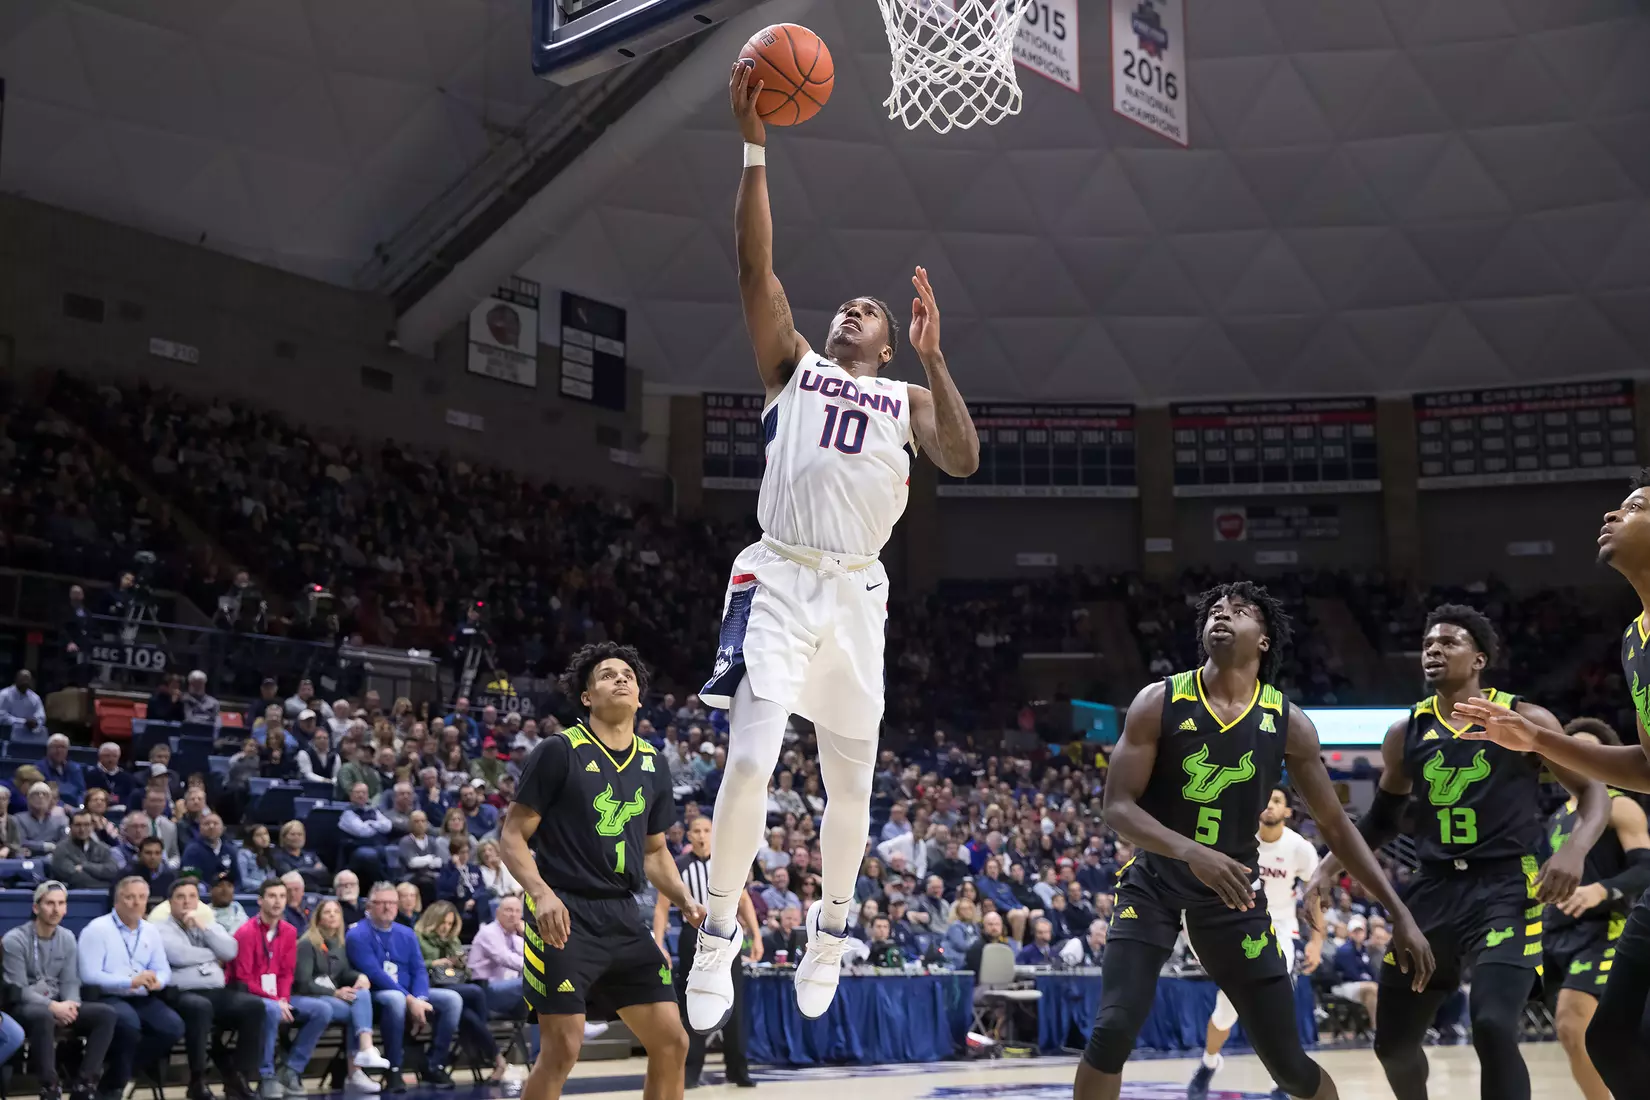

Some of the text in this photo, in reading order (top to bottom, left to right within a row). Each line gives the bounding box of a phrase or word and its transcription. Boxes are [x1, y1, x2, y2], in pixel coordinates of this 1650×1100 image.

[1013, 44, 1071, 82] HAMPIONS
[1016, 28, 1067, 62] ATIONAL
[1123, 49, 1178, 100] 2016
[1121, 100, 1181, 138] CHAMPIONS
[1125, 84, 1176, 119] NATIONAL
[799, 369, 902, 420] UCONN
[818, 403, 870, 455] 10
[92, 646, 167, 670] SEC 109
[1195, 806, 1222, 845] 5
[1436, 807, 1478, 845] 13
[613, 841, 627, 874] 1
[1259, 865, 1287, 879] ONN
